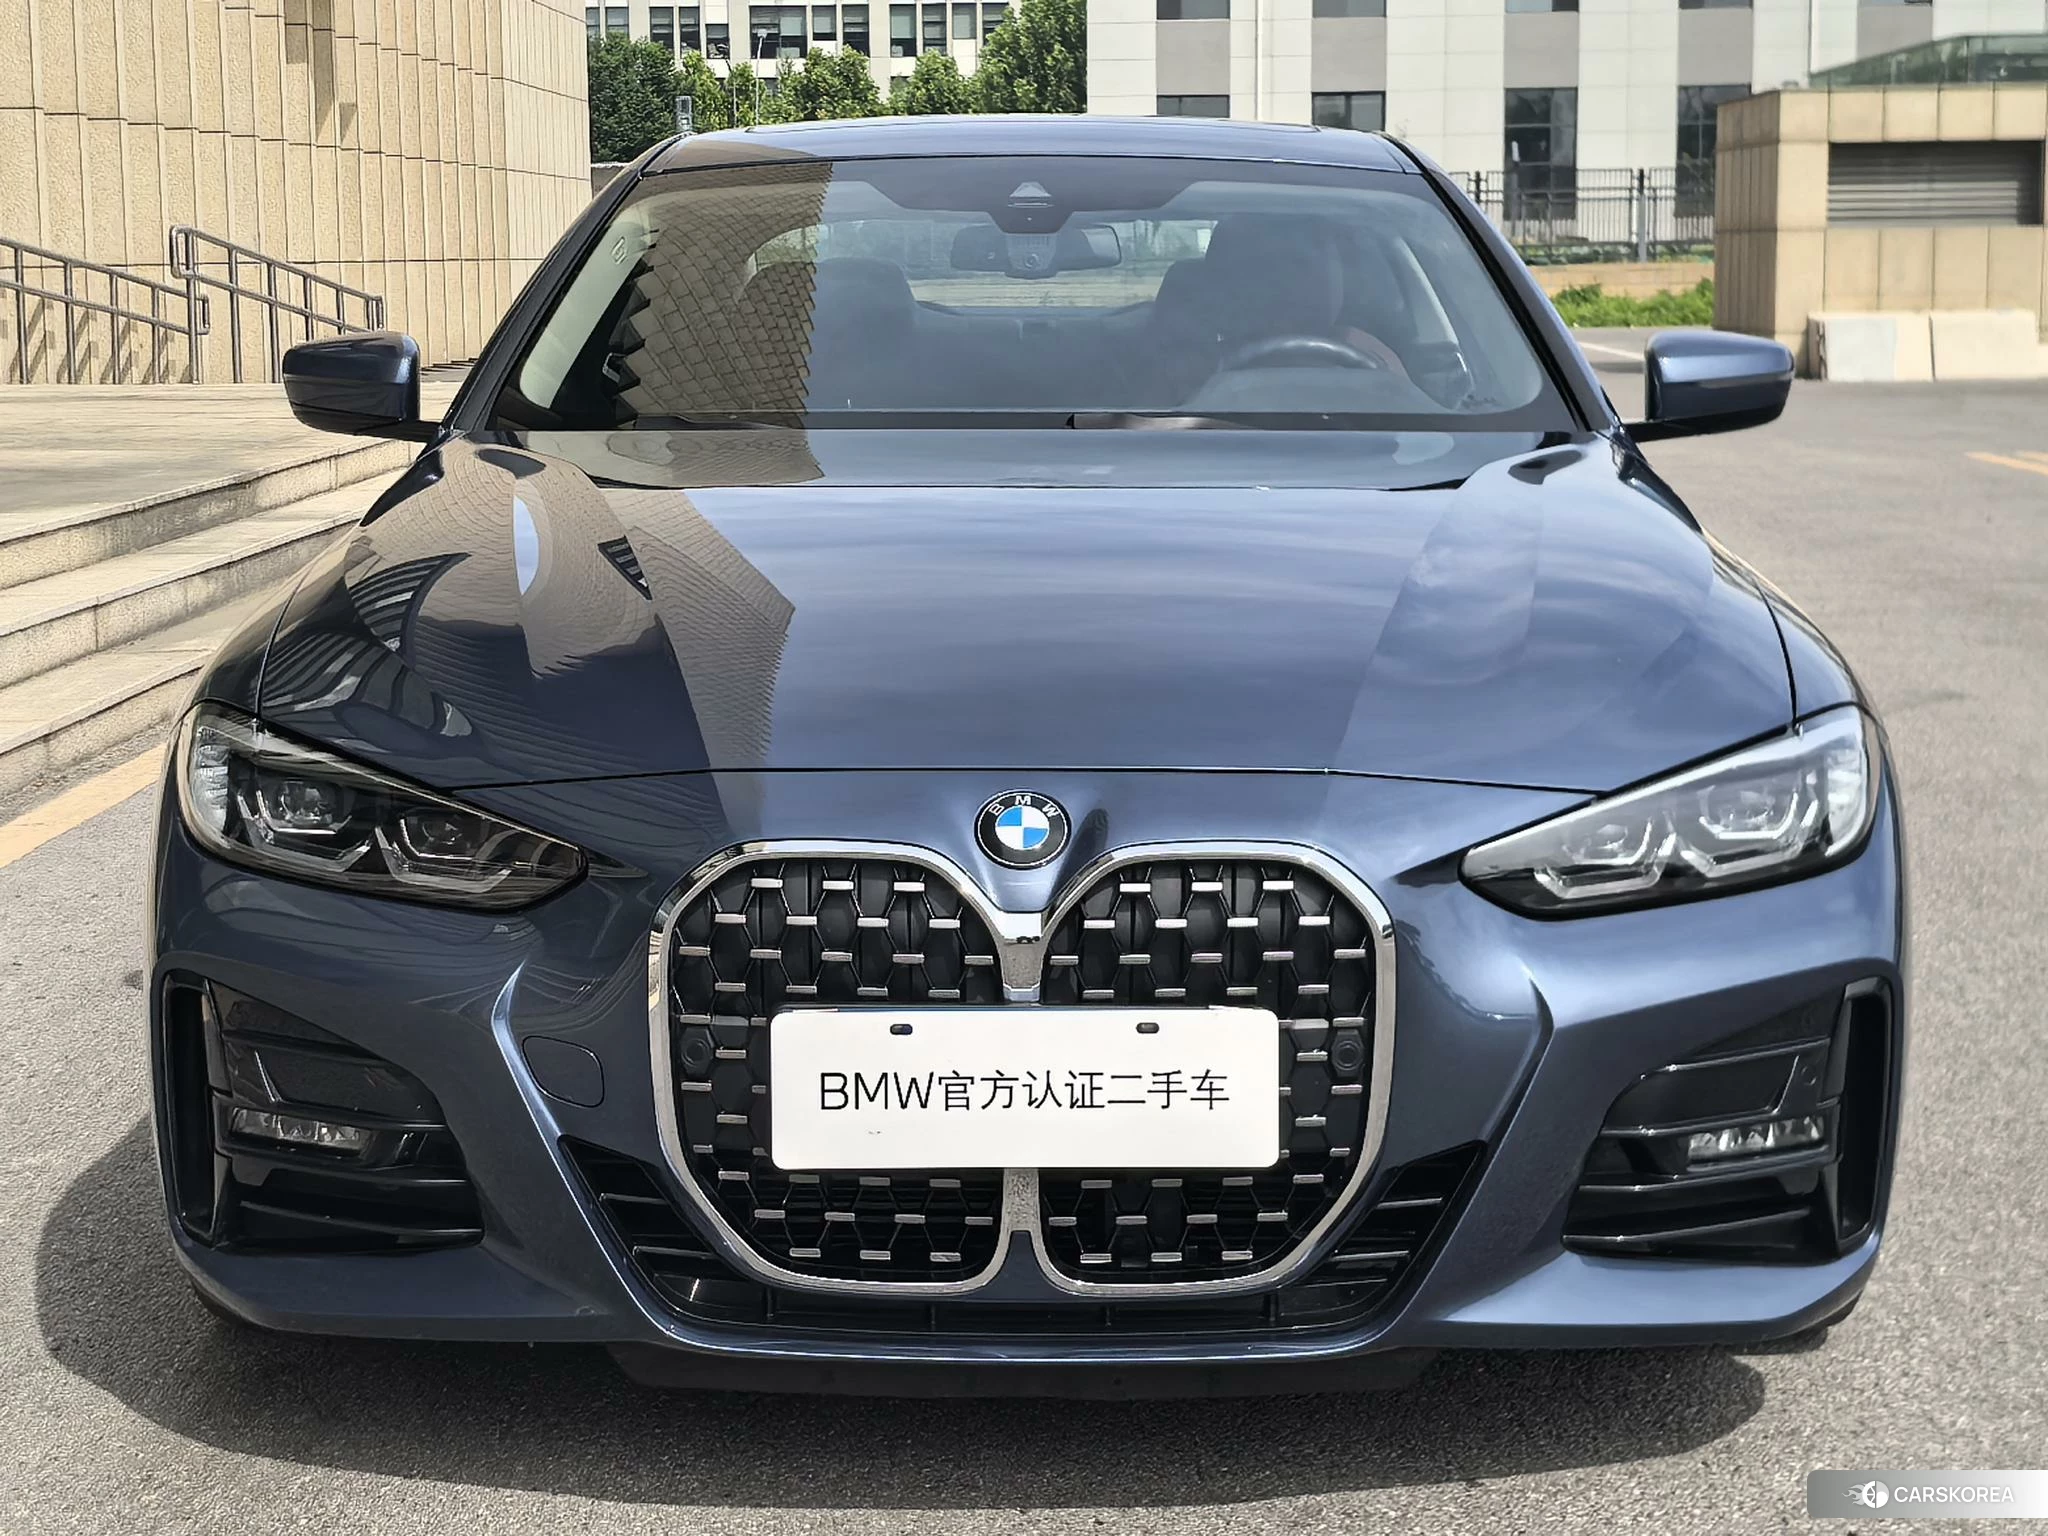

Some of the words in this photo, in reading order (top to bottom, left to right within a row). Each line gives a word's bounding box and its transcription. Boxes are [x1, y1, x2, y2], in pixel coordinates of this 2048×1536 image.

[989, 795, 1060, 817] BMW
[820, 1069, 1230, 1111] BMW官方认证二手车
